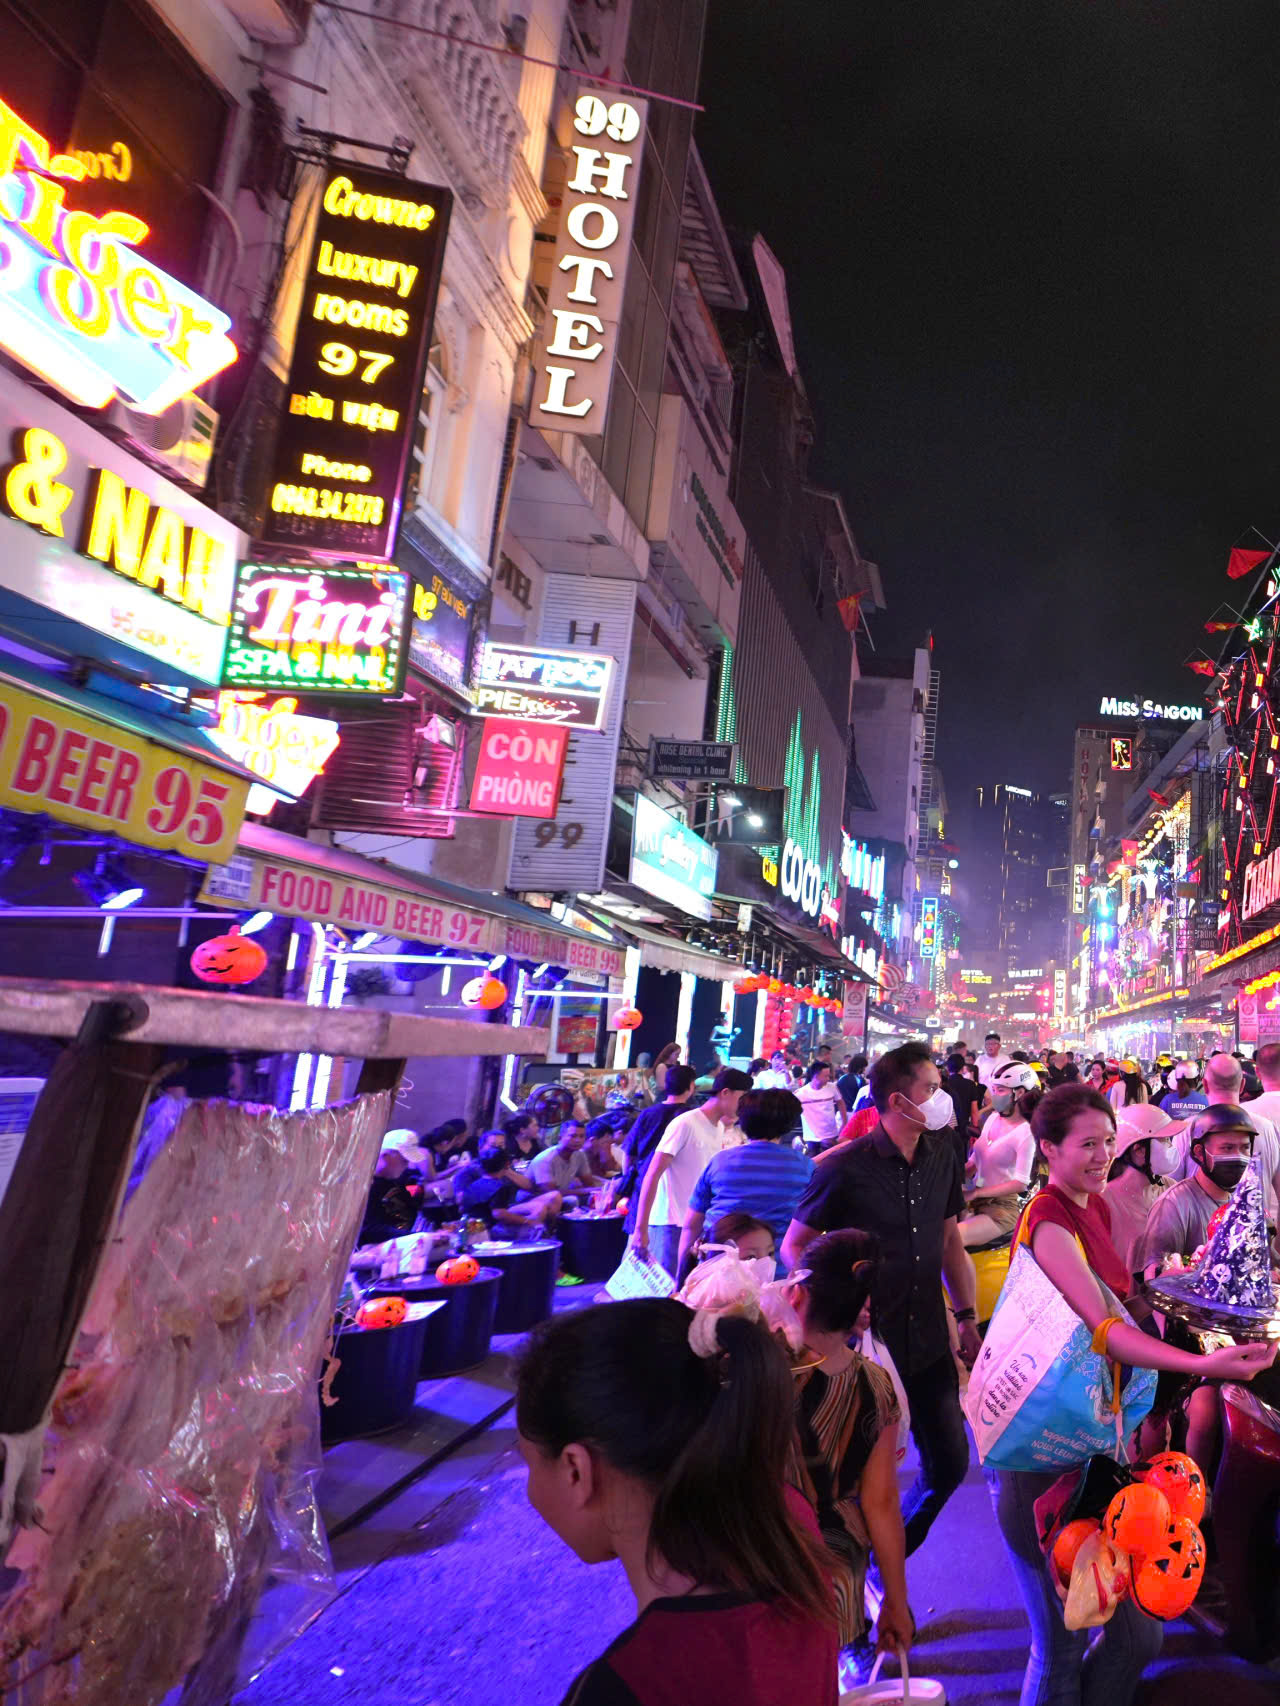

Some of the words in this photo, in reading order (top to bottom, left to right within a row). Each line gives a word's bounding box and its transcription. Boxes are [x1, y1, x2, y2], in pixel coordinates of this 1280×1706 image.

[574, 96, 641, 143] 99
[323, 176, 435, 231] Crowne
[317, 240, 419, 298] Luxury
[539, 145, 633, 418] HOTEL
[313, 293, 409, 337] rooms
[318, 342, 395, 384] 97
[6, 427, 74, 538] &
[301, 453, 372, 483] Phone
[243, 574, 393, 647] Tini
[227, 649, 293, 677] SPA
[295, 651, 322, 679] &
[322, 653, 391, 683] NAIL
[1100, 697, 1139, 717] MISS
[1143, 700, 1203, 720] SAIGON
[486, 728, 560, 766] CÒN
[679, 745, 705, 757] DENTAL
[10, 714, 141, 824] BEER
[146, 766, 232, 845] 95
[477, 771, 553, 807] PHÒNG
[709, 765, 727, 776] hour
[534, 821, 584, 849] 99
[260, 865, 335, 915] FOOD
[338, 886, 388, 928] AND
[392, 899, 444, 939] BEER
[448, 910, 487, 946] 97
[505, 925, 539, 956] FOOD
[543, 934, 569, 962] AND
[569, 941, 598, 969] BEER
[600, 950, 620, 974] 99
[921, 904, 937, 955] TATTOO
[1009, 1360, 1020, 1373] Un
[1018, 1372, 1028, 1383] sac
[984, 1398, 1000, 1418] nature
[988, 1389, 1001, 1405] dans
[999, 1401, 1007, 1411] la
[1031, 1439, 1054, 1453] NOUS
[1054, 1446, 1075, 1460] LEUR
